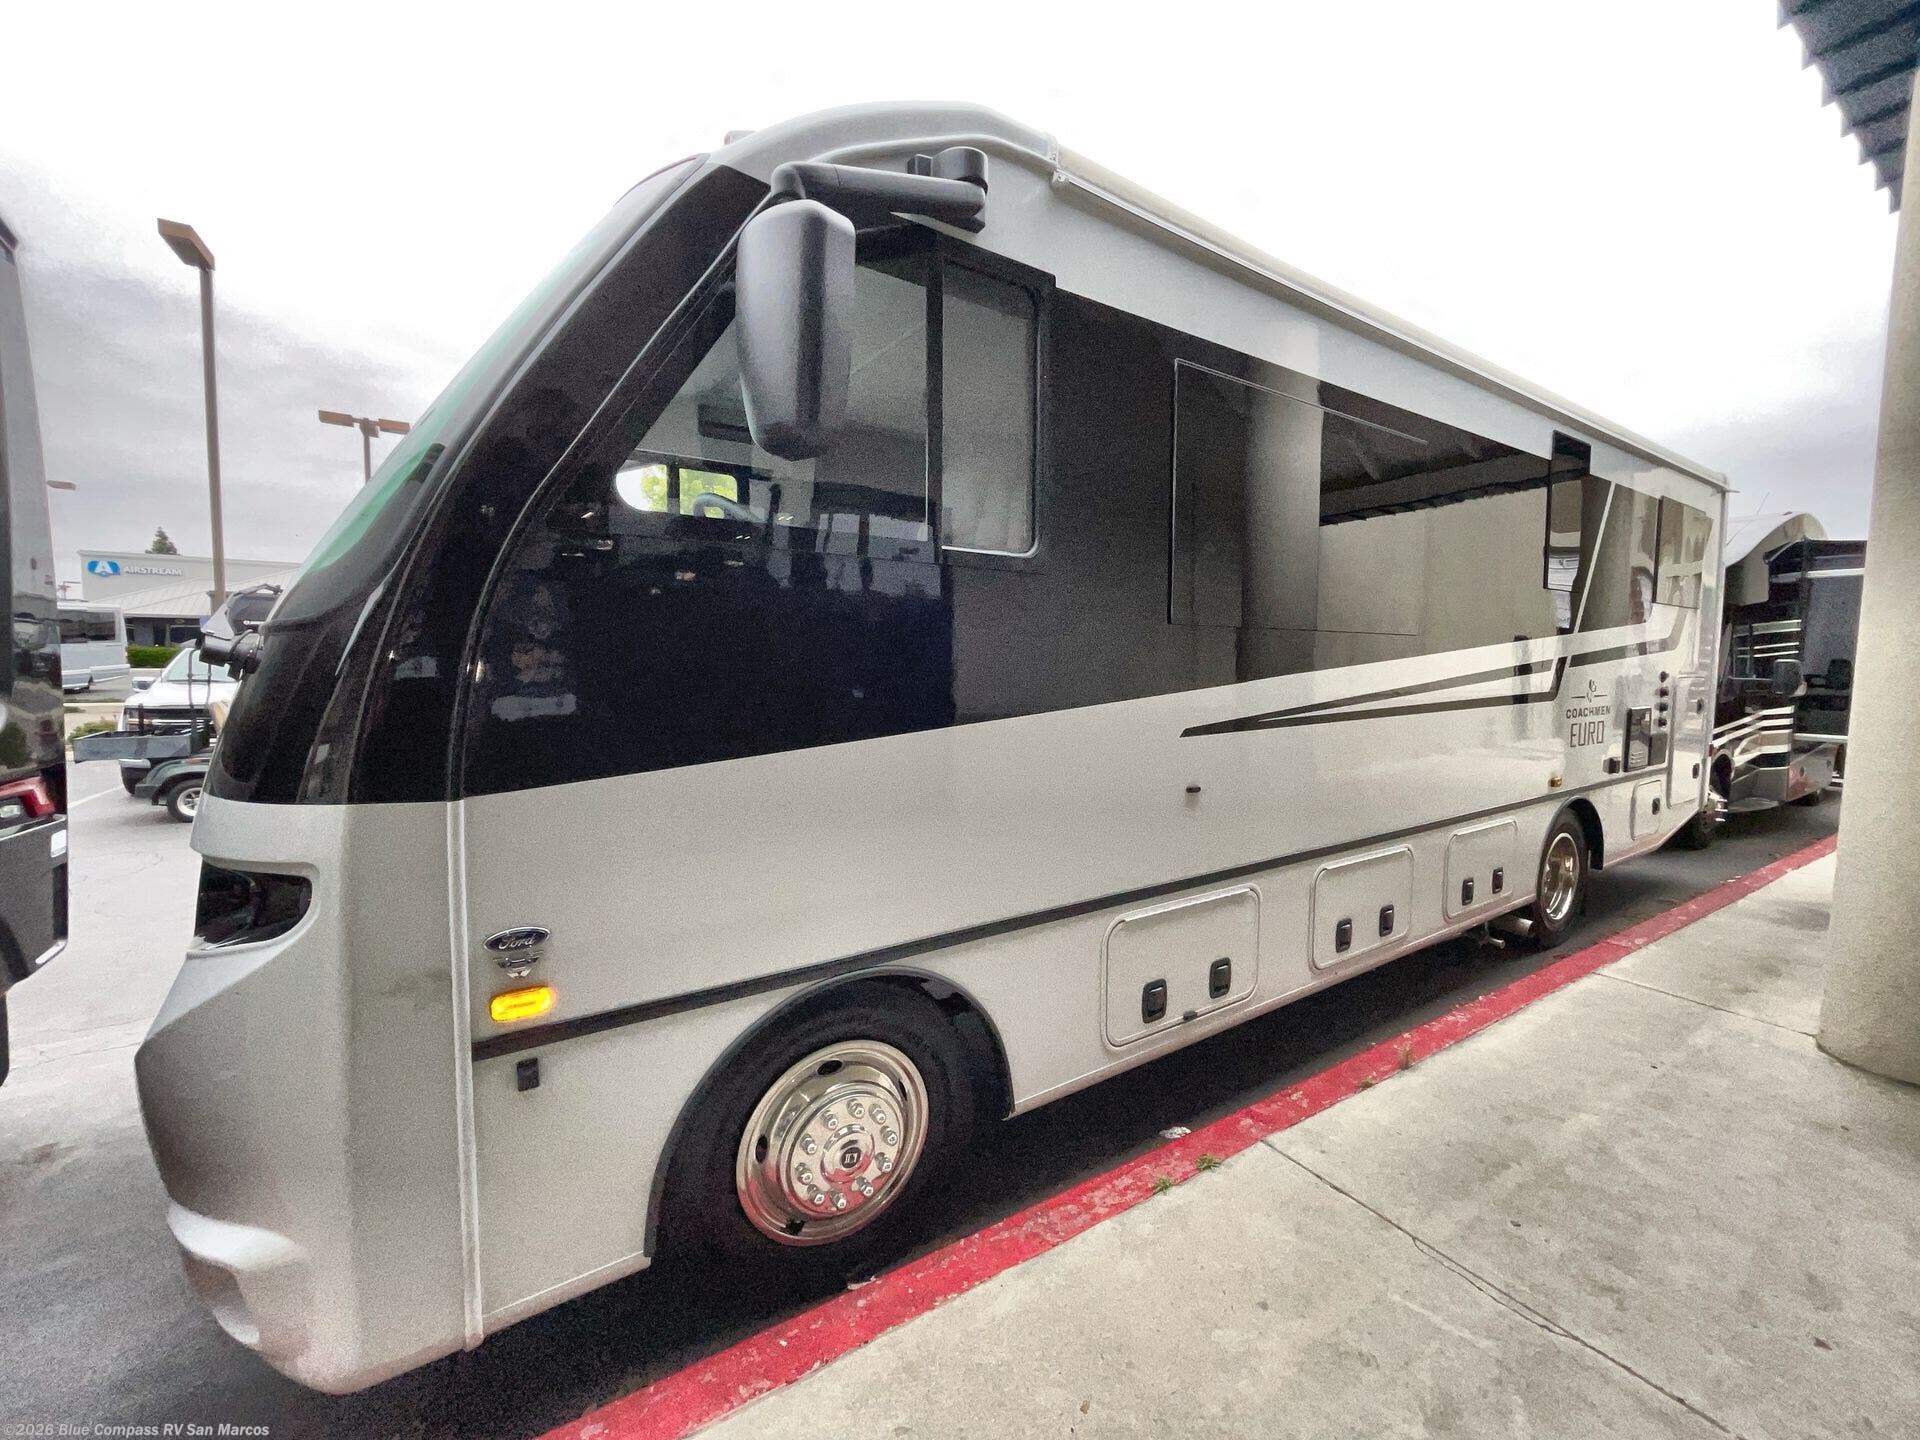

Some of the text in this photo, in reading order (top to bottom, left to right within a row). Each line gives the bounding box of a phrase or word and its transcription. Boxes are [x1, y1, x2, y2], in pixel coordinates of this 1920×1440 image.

[123, 565, 183, 576] AIRSTREAM
[1566, 705, 1611, 719] COACHMEN
[1570, 720, 1605, 747] EURO
[498, 932, 537, 950] Ford
